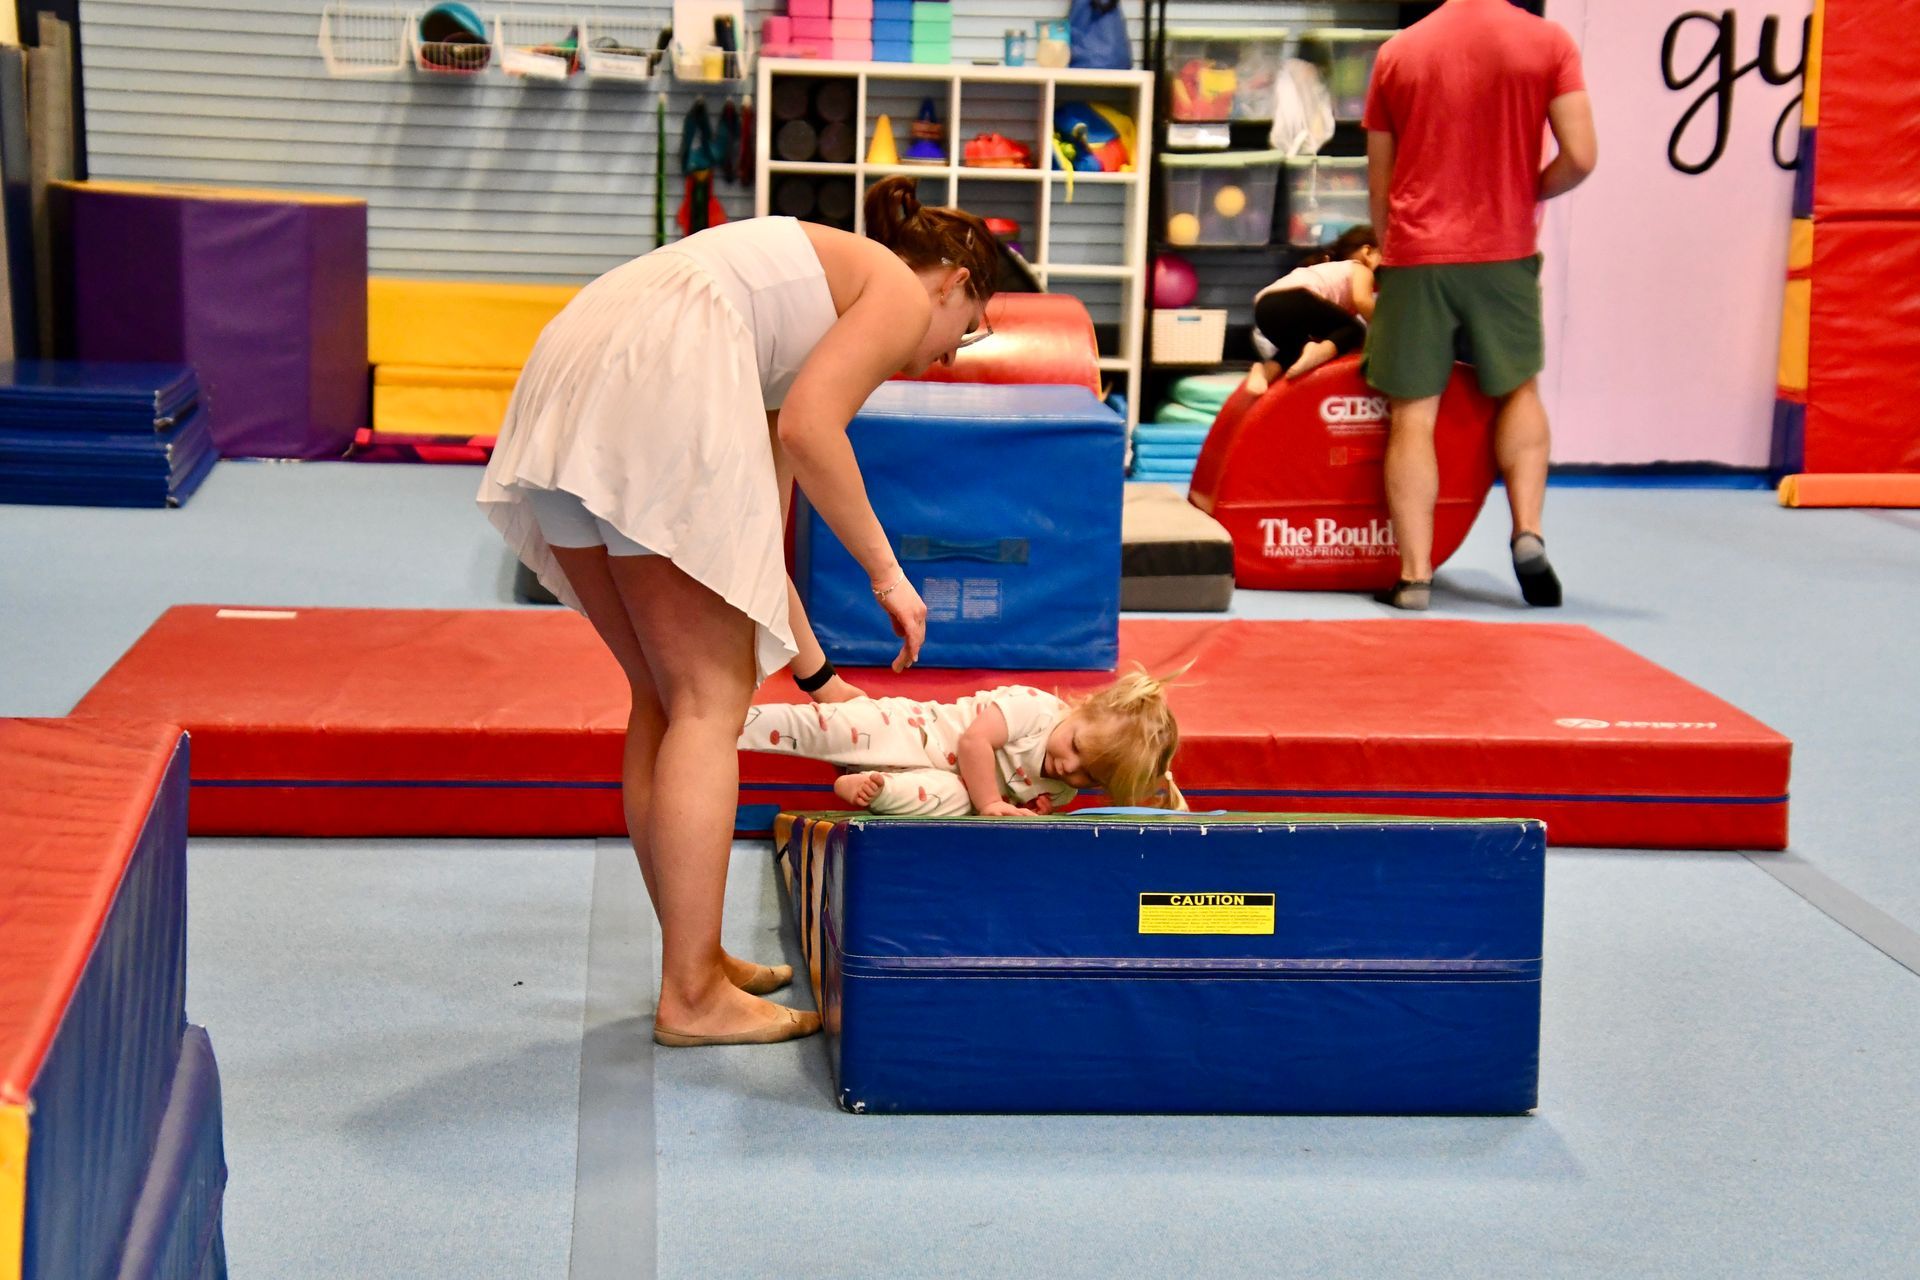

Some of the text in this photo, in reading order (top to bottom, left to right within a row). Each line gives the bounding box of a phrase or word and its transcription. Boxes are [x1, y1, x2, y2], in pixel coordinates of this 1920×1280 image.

[1257, 518, 1397, 547] The Bould
[1264, 546, 1355, 557] HANDSPRING
[1170, 895, 1245, 906] CAUTION
